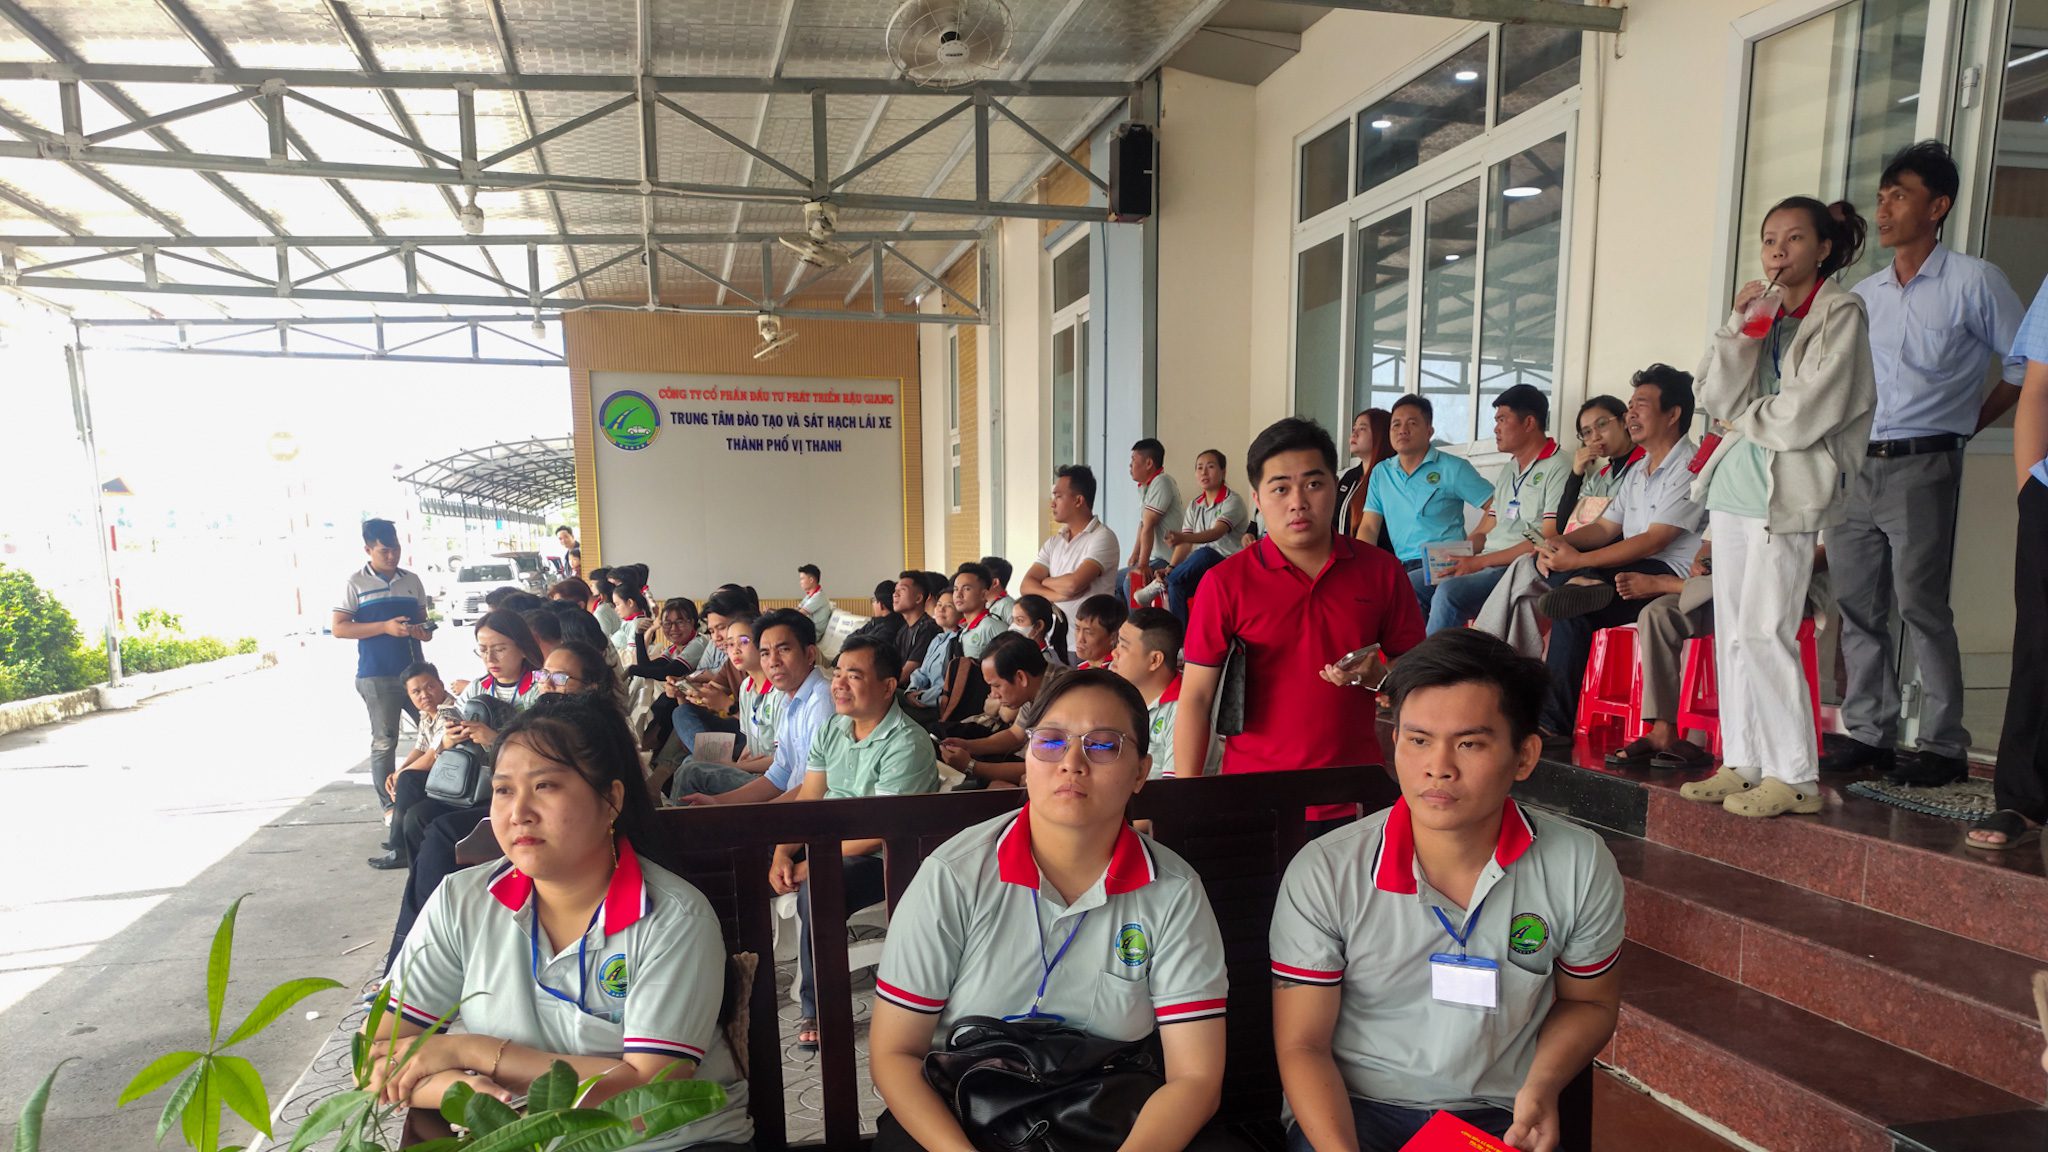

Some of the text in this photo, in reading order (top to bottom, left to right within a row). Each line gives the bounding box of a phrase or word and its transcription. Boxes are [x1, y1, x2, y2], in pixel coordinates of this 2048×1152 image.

[658, 386, 687, 399] CÔNG
[689, 389, 701, 400] TY
[864, 393, 894, 405] GIANG
[670, 410, 892, 431] TRUNG TÂM ĐÀO TẠO VÀ SÁT HẠCH LÁI XE
[726, 434, 842, 455] THÀNH PHỐ VỊ THANH
